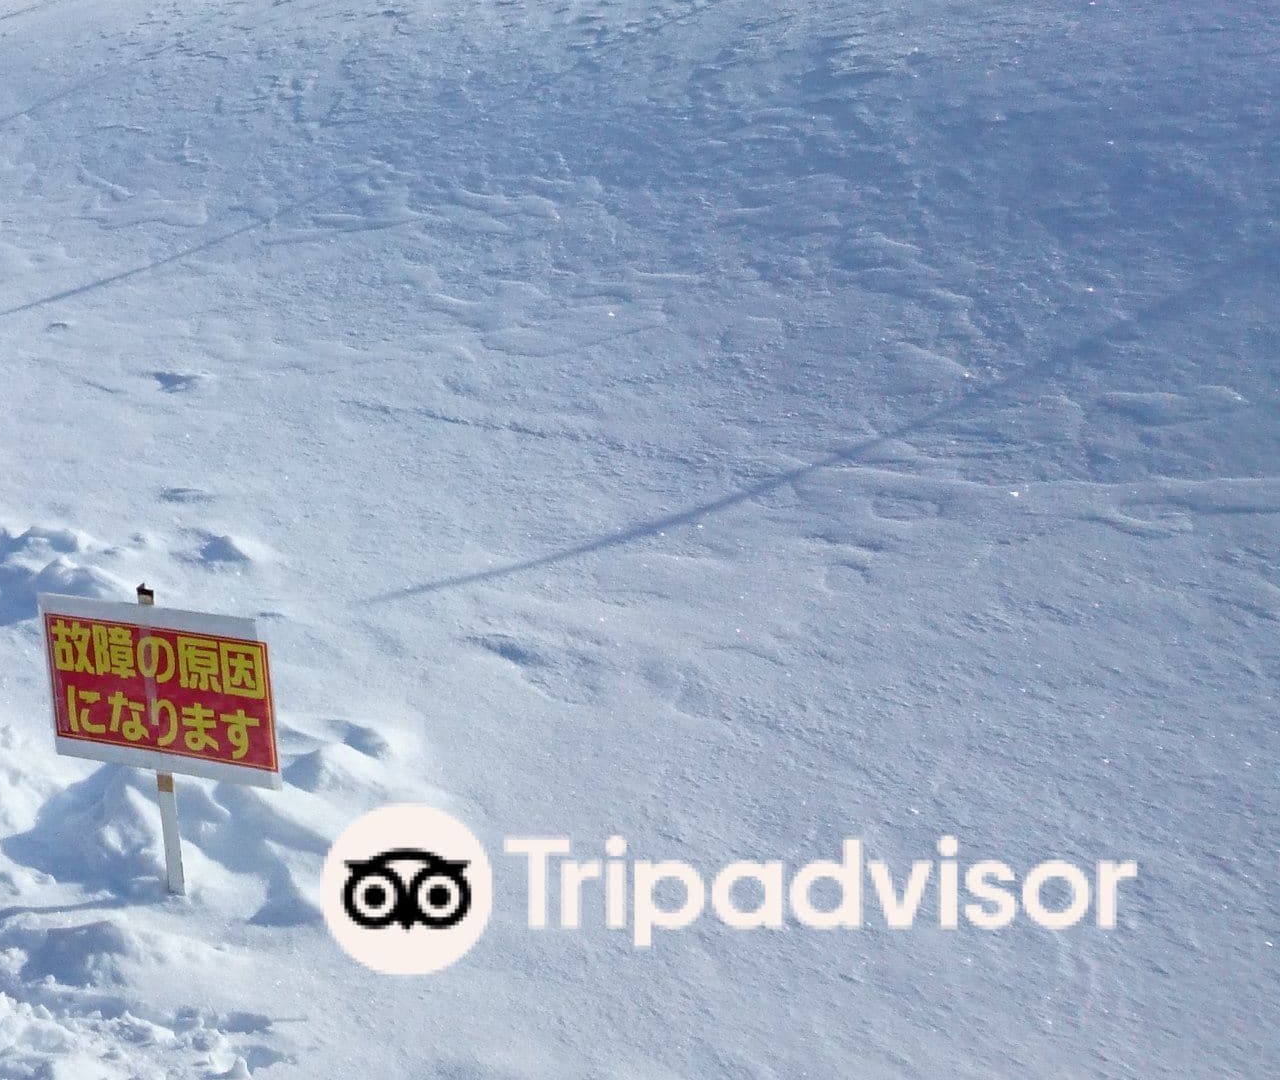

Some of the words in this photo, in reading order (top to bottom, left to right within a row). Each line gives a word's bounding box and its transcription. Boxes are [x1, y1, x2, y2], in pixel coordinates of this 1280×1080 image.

[50, 619, 266, 699] 故障の原因
[66, 685, 260, 759] になります
